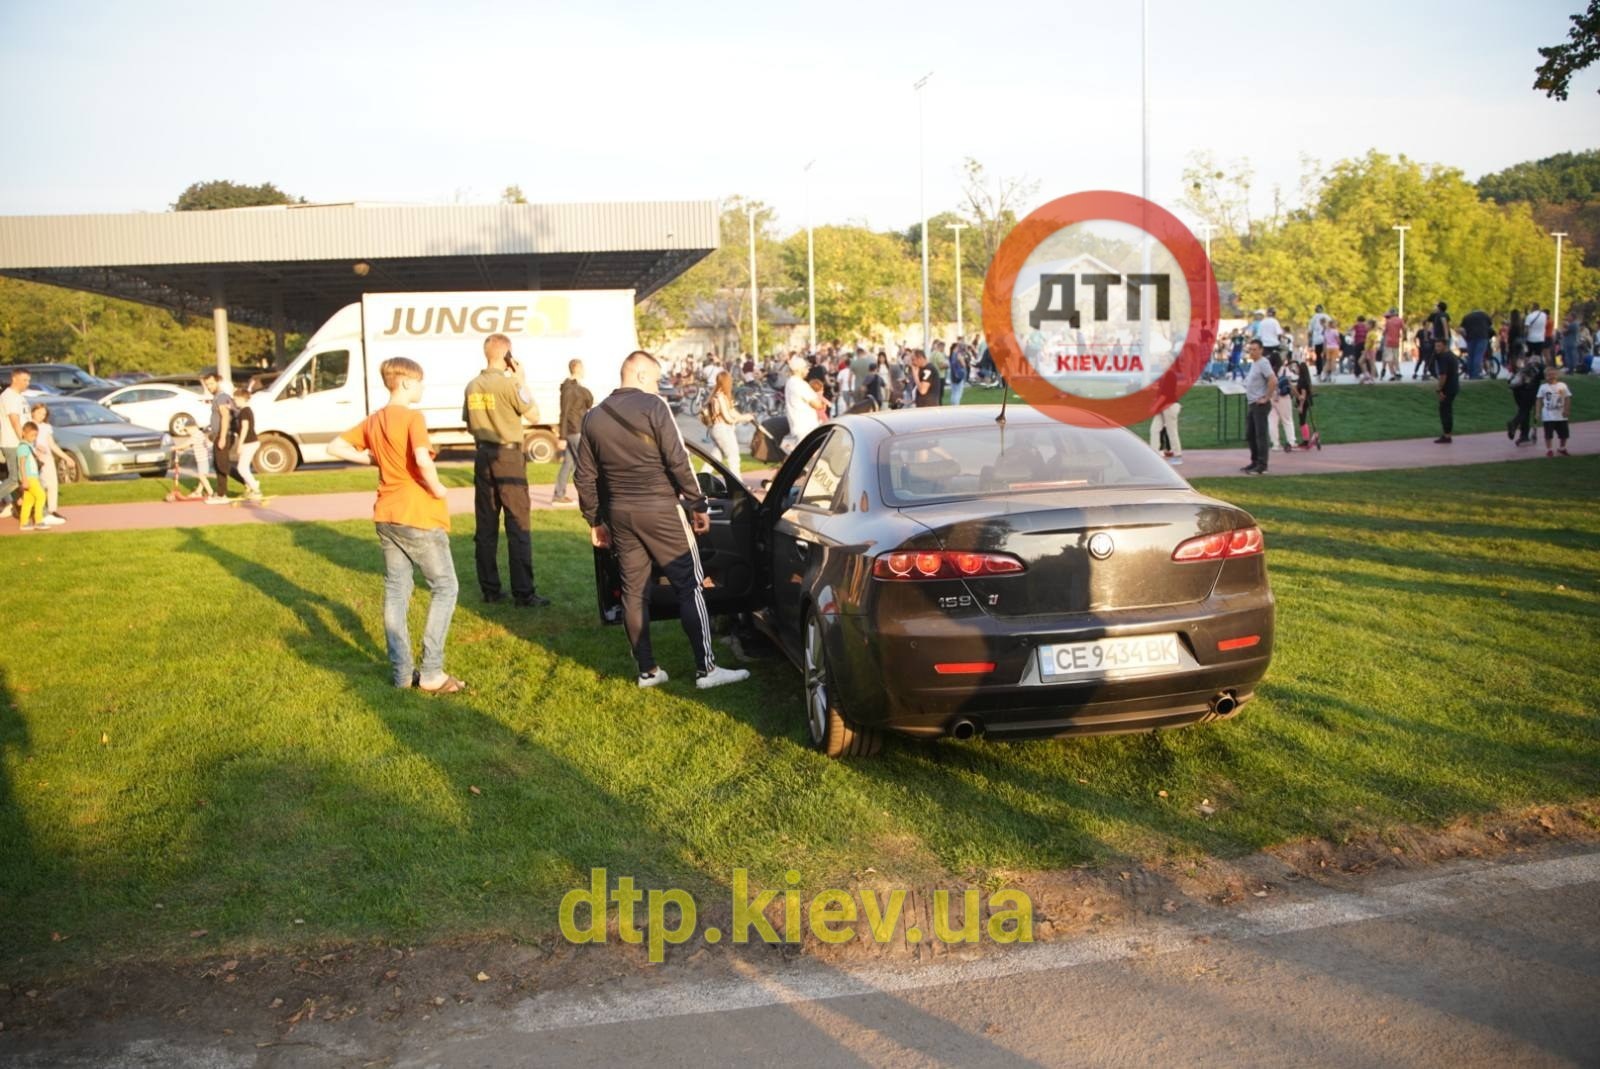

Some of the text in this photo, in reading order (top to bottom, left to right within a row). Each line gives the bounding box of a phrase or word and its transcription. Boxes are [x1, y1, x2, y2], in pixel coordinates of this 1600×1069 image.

[383, 306, 528, 336] JUNGE
[939, 595, 972, 608] 159
[1056, 639, 1177, 670] CE 9434 BK
